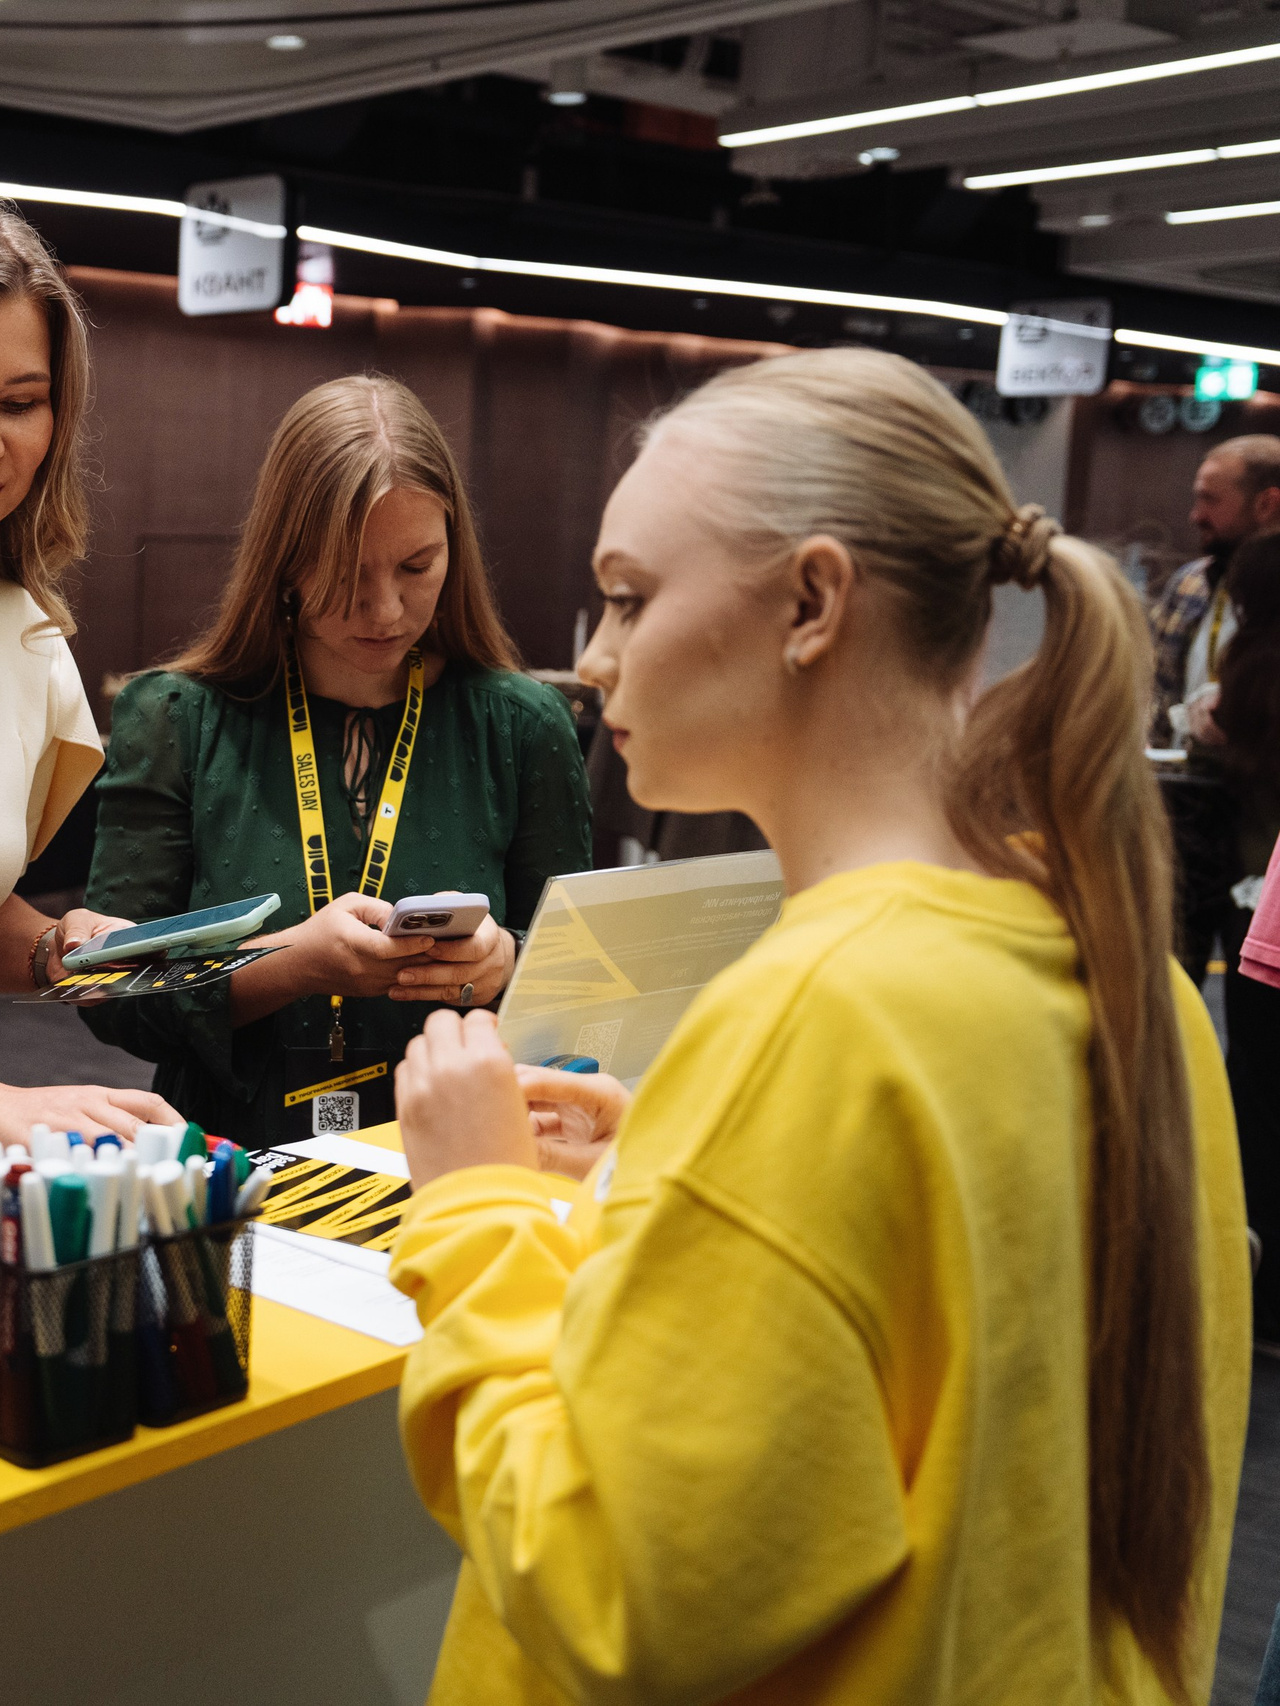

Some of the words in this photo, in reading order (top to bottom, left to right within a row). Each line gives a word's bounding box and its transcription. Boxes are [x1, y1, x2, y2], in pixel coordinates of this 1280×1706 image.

[296, 753, 315, 787] SALES
[301, 790, 319, 811] DAY
[298, 1083, 333, 1098] ПРОГРАММА
